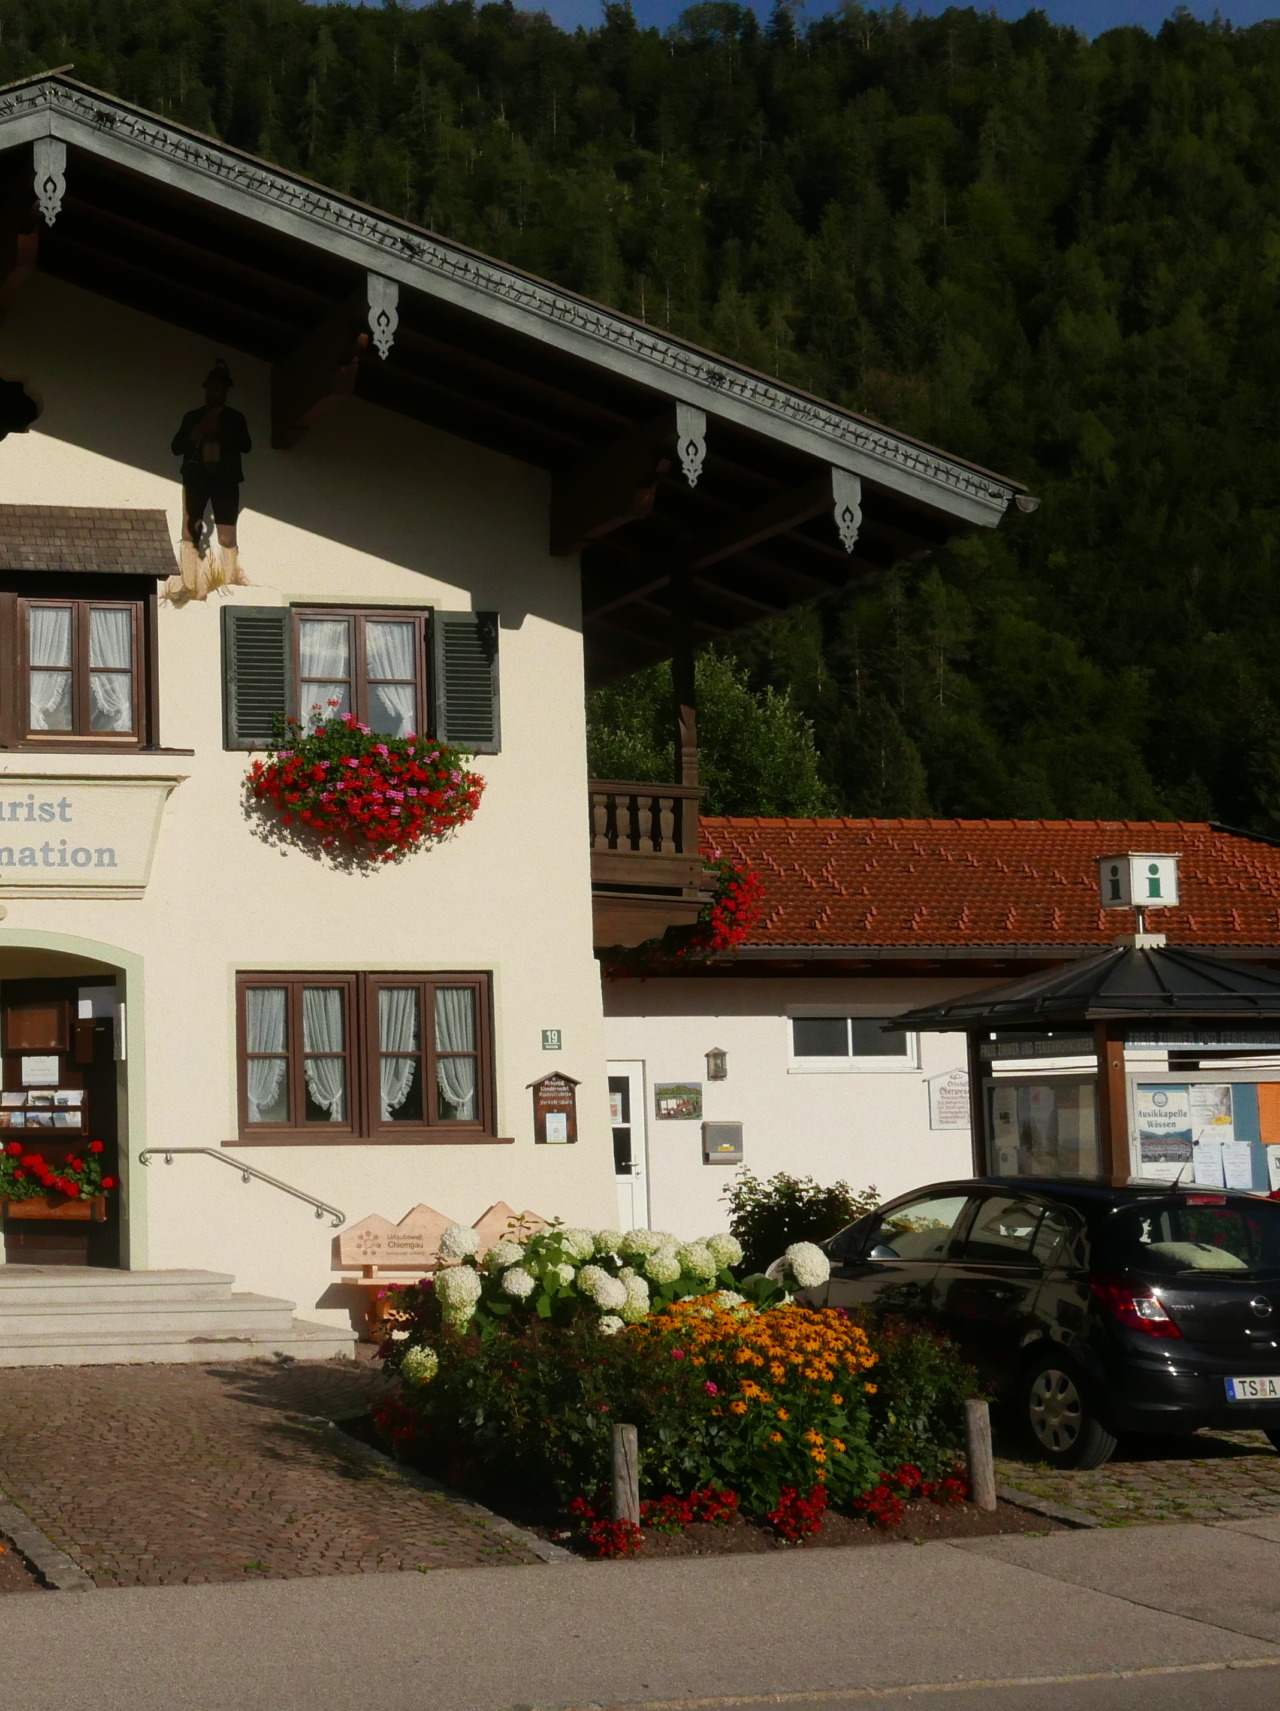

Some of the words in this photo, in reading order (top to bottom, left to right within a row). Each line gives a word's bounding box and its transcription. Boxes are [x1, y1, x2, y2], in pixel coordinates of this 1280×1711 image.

[546, 1030, 558, 1043] 19
[1158, 1032, 1194, 1046] ZIMMER
[1197, 1032, 1217, 1046] UND
[387, 1241, 424, 1249] Chiemgau
[1238, 1380, 1258, 1397] TS
[1268, 1379, 1278, 1396] A
